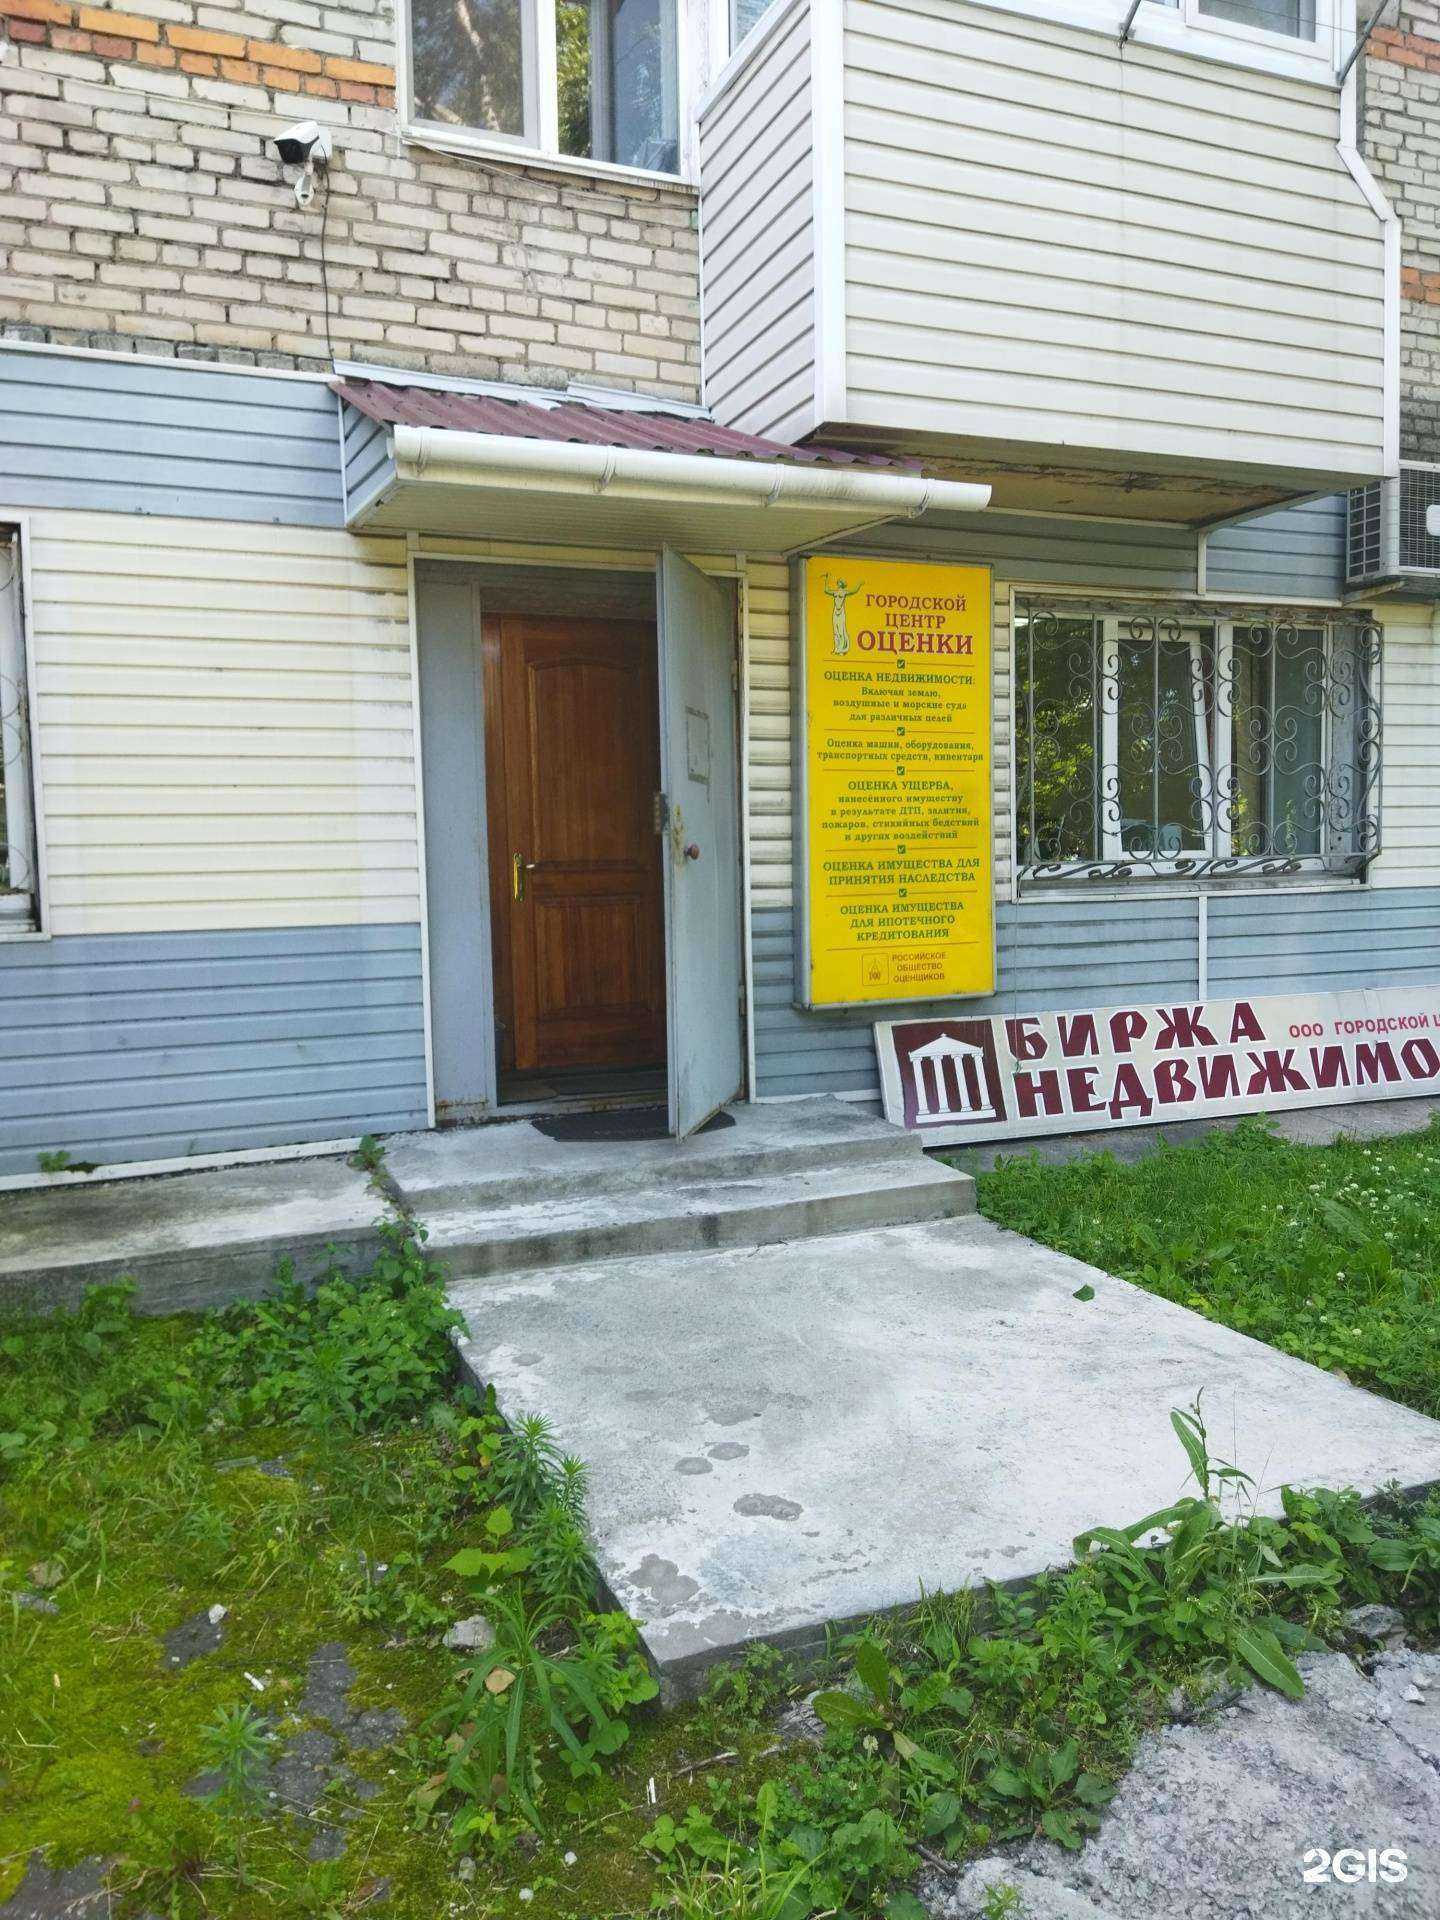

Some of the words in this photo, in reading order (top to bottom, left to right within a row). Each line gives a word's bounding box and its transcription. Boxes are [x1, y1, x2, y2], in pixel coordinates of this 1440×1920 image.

[866, 594, 966, 612] ГОРОДСКОЙ
[885, 613, 946, 629] ЦЕНТР
[857, 630, 973, 655] ОЦЕНКИ
[824, 671, 872, 682] ОЦЕНКА
[861, 687, 904, 696] Включая
[907, 689, 941, 698] землю,
[833, 700, 890, 709] воздушные
[903, 701, 942, 710] морские
[946, 703, 966, 711] суда
[849, 714, 868, 722] для
[870, 714, 922, 723] различных
[925, 714, 952, 723] целей
[827, 739, 863, 748] Оценка
[866, 741, 902, 749] машин,
[905, 741, 974, 751] оборудования,
[817, 751, 888, 761] транспортных
[891, 753, 931, 762] средств,
[848, 781, 897, 791] ОЦЕНКА
[902, 781, 953, 791] УЩЕРБА,
[838, 795, 903, 803] нанесённого
[906, 795, 964, 803] имуществу
[840, 808, 896, 817] результате
[899, 807, 924, 816] ДТП,
[872, 820, 929, 828] стихийных
[932, 818, 979, 826] бедствий
[854, 833, 890, 842] других
[893, 831, 958, 840] воздействий
[823, 861, 874, 873] ОЦЕНКА
[878, 859, 952, 871] ИМУЩЕСТВА
[957, 858, 980, 868] ДЛЯ
[829, 874, 895, 886] ПРИНЯТИЯ
[898, 872, 976, 884] НАСЛЕДСТВА
[840, 904, 889, 915] ОЦЕНКА
[892, 902, 964, 913] ИМУЩЕСТВА
[850, 919, 874, 929] ДЛЯ
[878, 916, 955, 927] ИПОТЕЧНОГО
[856, 929, 949, 941] КРЕДИТОВАНИЯ
[892, 951, 947, 961] РОССИЙСКОЕ
[897, 963, 942, 971] ОБЩЕСТВО
[893, 972, 945, 983] ОЦЕНЩИКОВ
[1289, 1023, 1324, 1038] ООО
[1334, 1011, 1429, 1034] ГОРОДСКОЙ
[1004, 1002, 1266, 1061] БИРЖА
[1014, 1037, 1440, 1120] НЕДВИЖИМО
